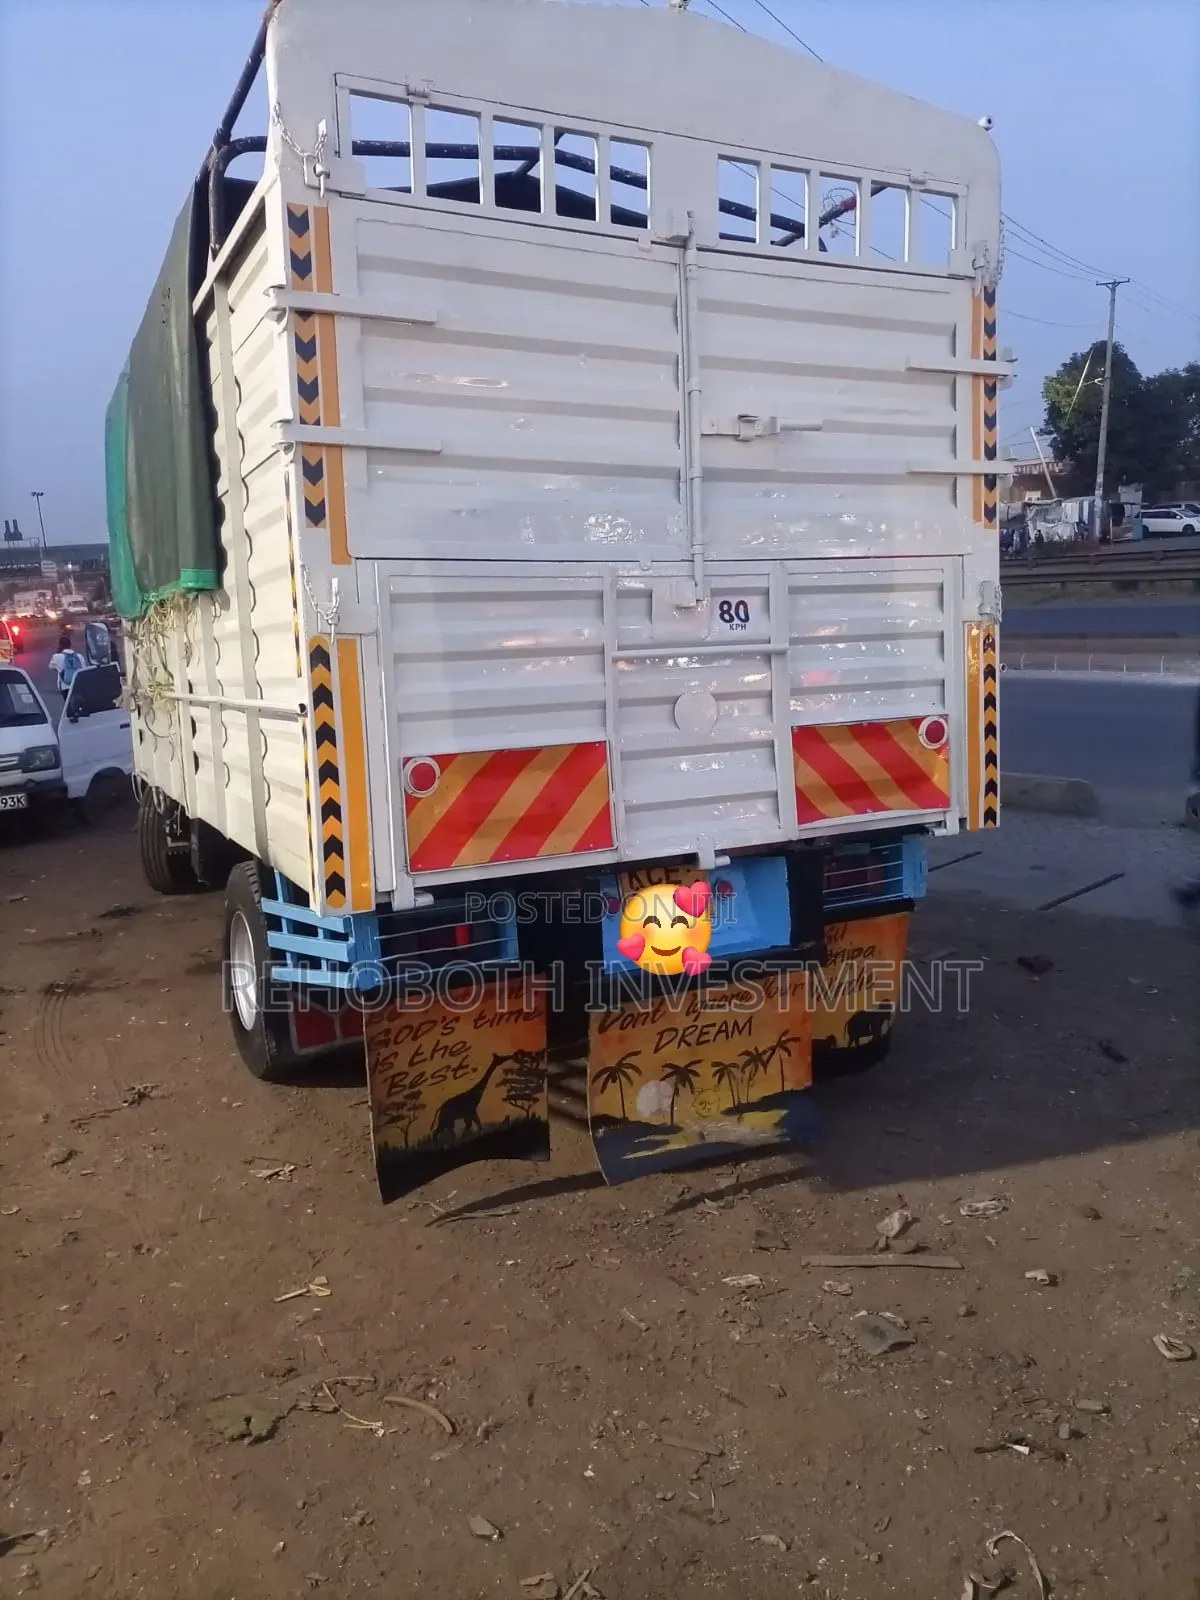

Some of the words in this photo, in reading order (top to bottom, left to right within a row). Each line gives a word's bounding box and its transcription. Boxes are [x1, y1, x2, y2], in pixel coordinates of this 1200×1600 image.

[718, 599, 750, 624] 80
[729, 623, 747, 631] KPH
[653, 1015, 753, 1054] DREAM
[372, 1051, 400, 1074] is
[407, 1039, 473, 1068] the
